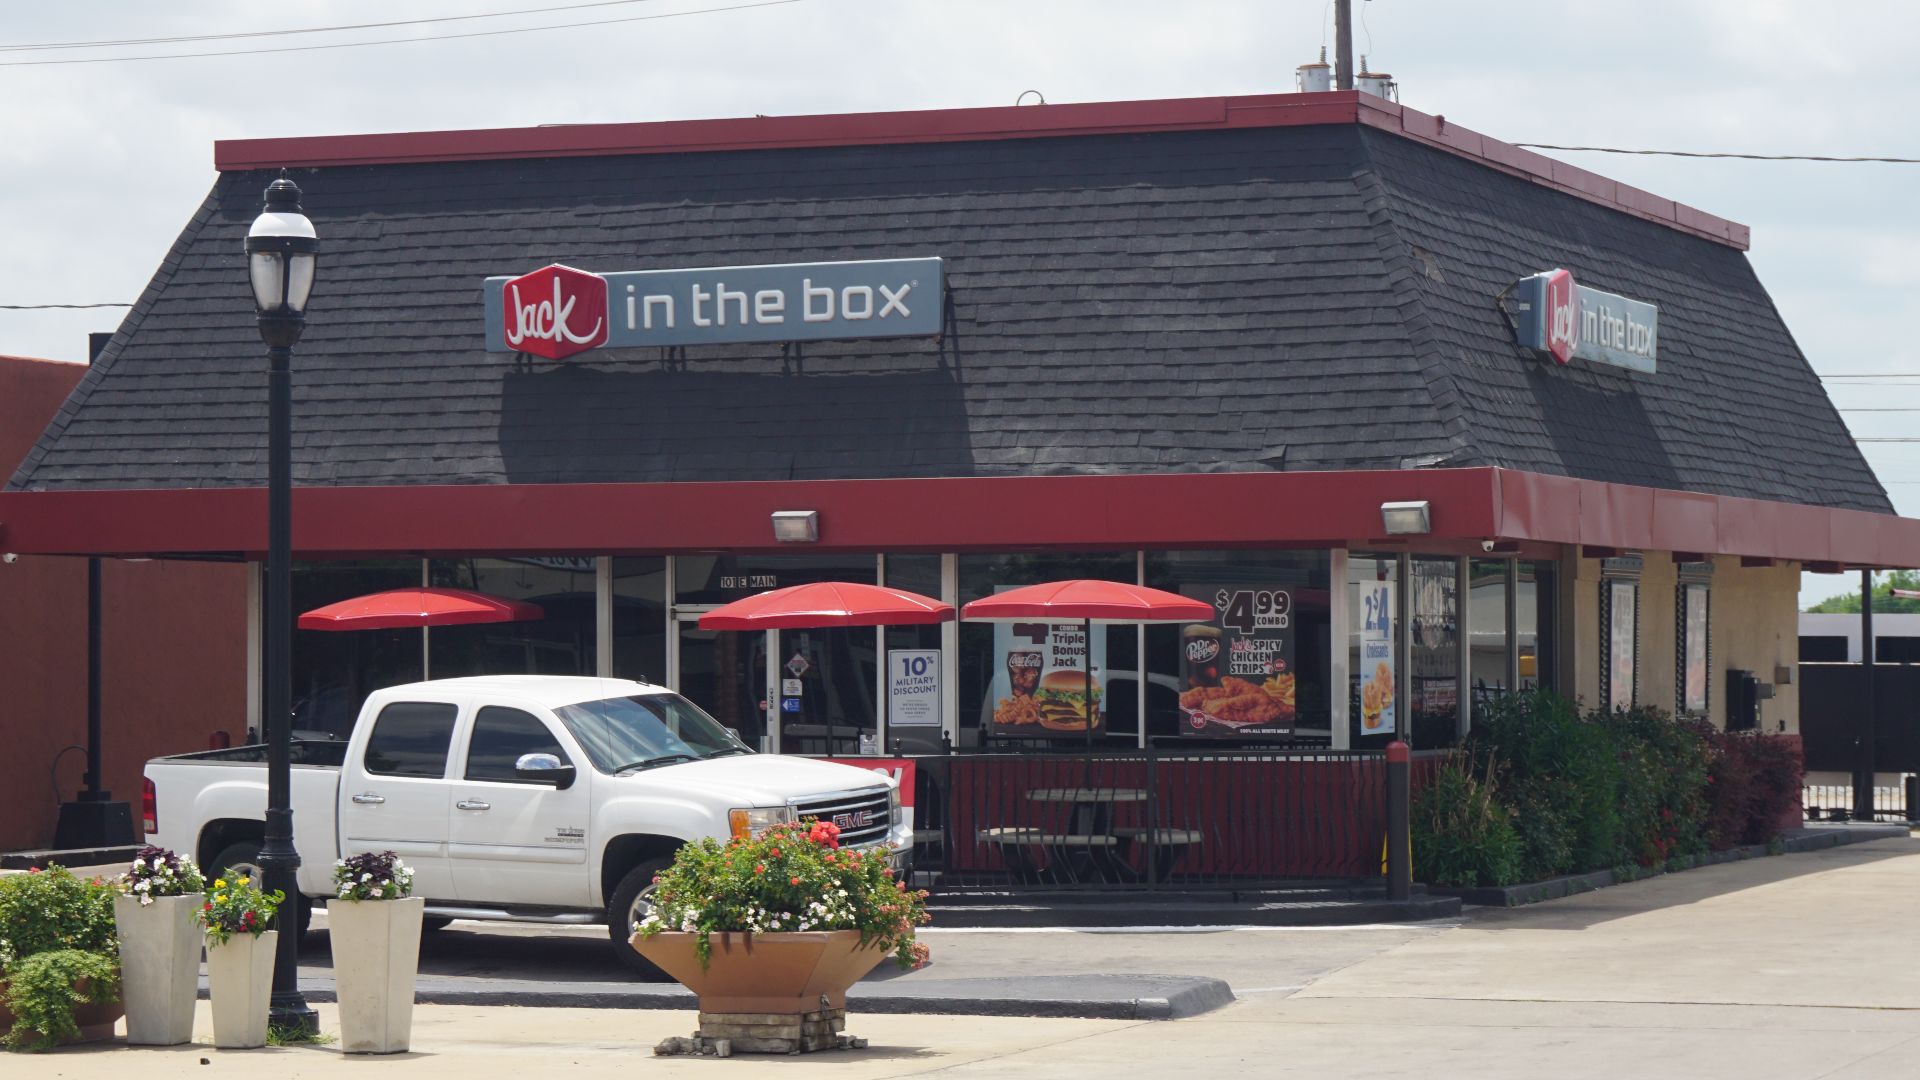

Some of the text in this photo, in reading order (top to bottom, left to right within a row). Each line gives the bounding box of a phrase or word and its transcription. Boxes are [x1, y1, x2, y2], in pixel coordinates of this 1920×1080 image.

[507, 276, 911, 345] Jack in the box
[1550, 282, 1653, 358] Jack in the box
[721, 575, 777, 588] 101 E MAIN
[1256, 616, 1287, 625] COMBO
[1053, 633, 1085, 645] Triple
[1053, 645, 1086, 656] Bonus
[1197, 640, 1210, 650] Dr
[1253, 640, 1282, 651] SPICY
[1053, 657, 1077, 667] Jack
[1231, 652, 1271, 662] CHICKEN
[902, 656, 934, 676] 10%
[1231, 663, 1265, 674] STRIPS
[896, 676, 934, 686] MILITARY
[893, 685, 937, 695] DISCOUNT
[833, 810, 873, 829] GMC
